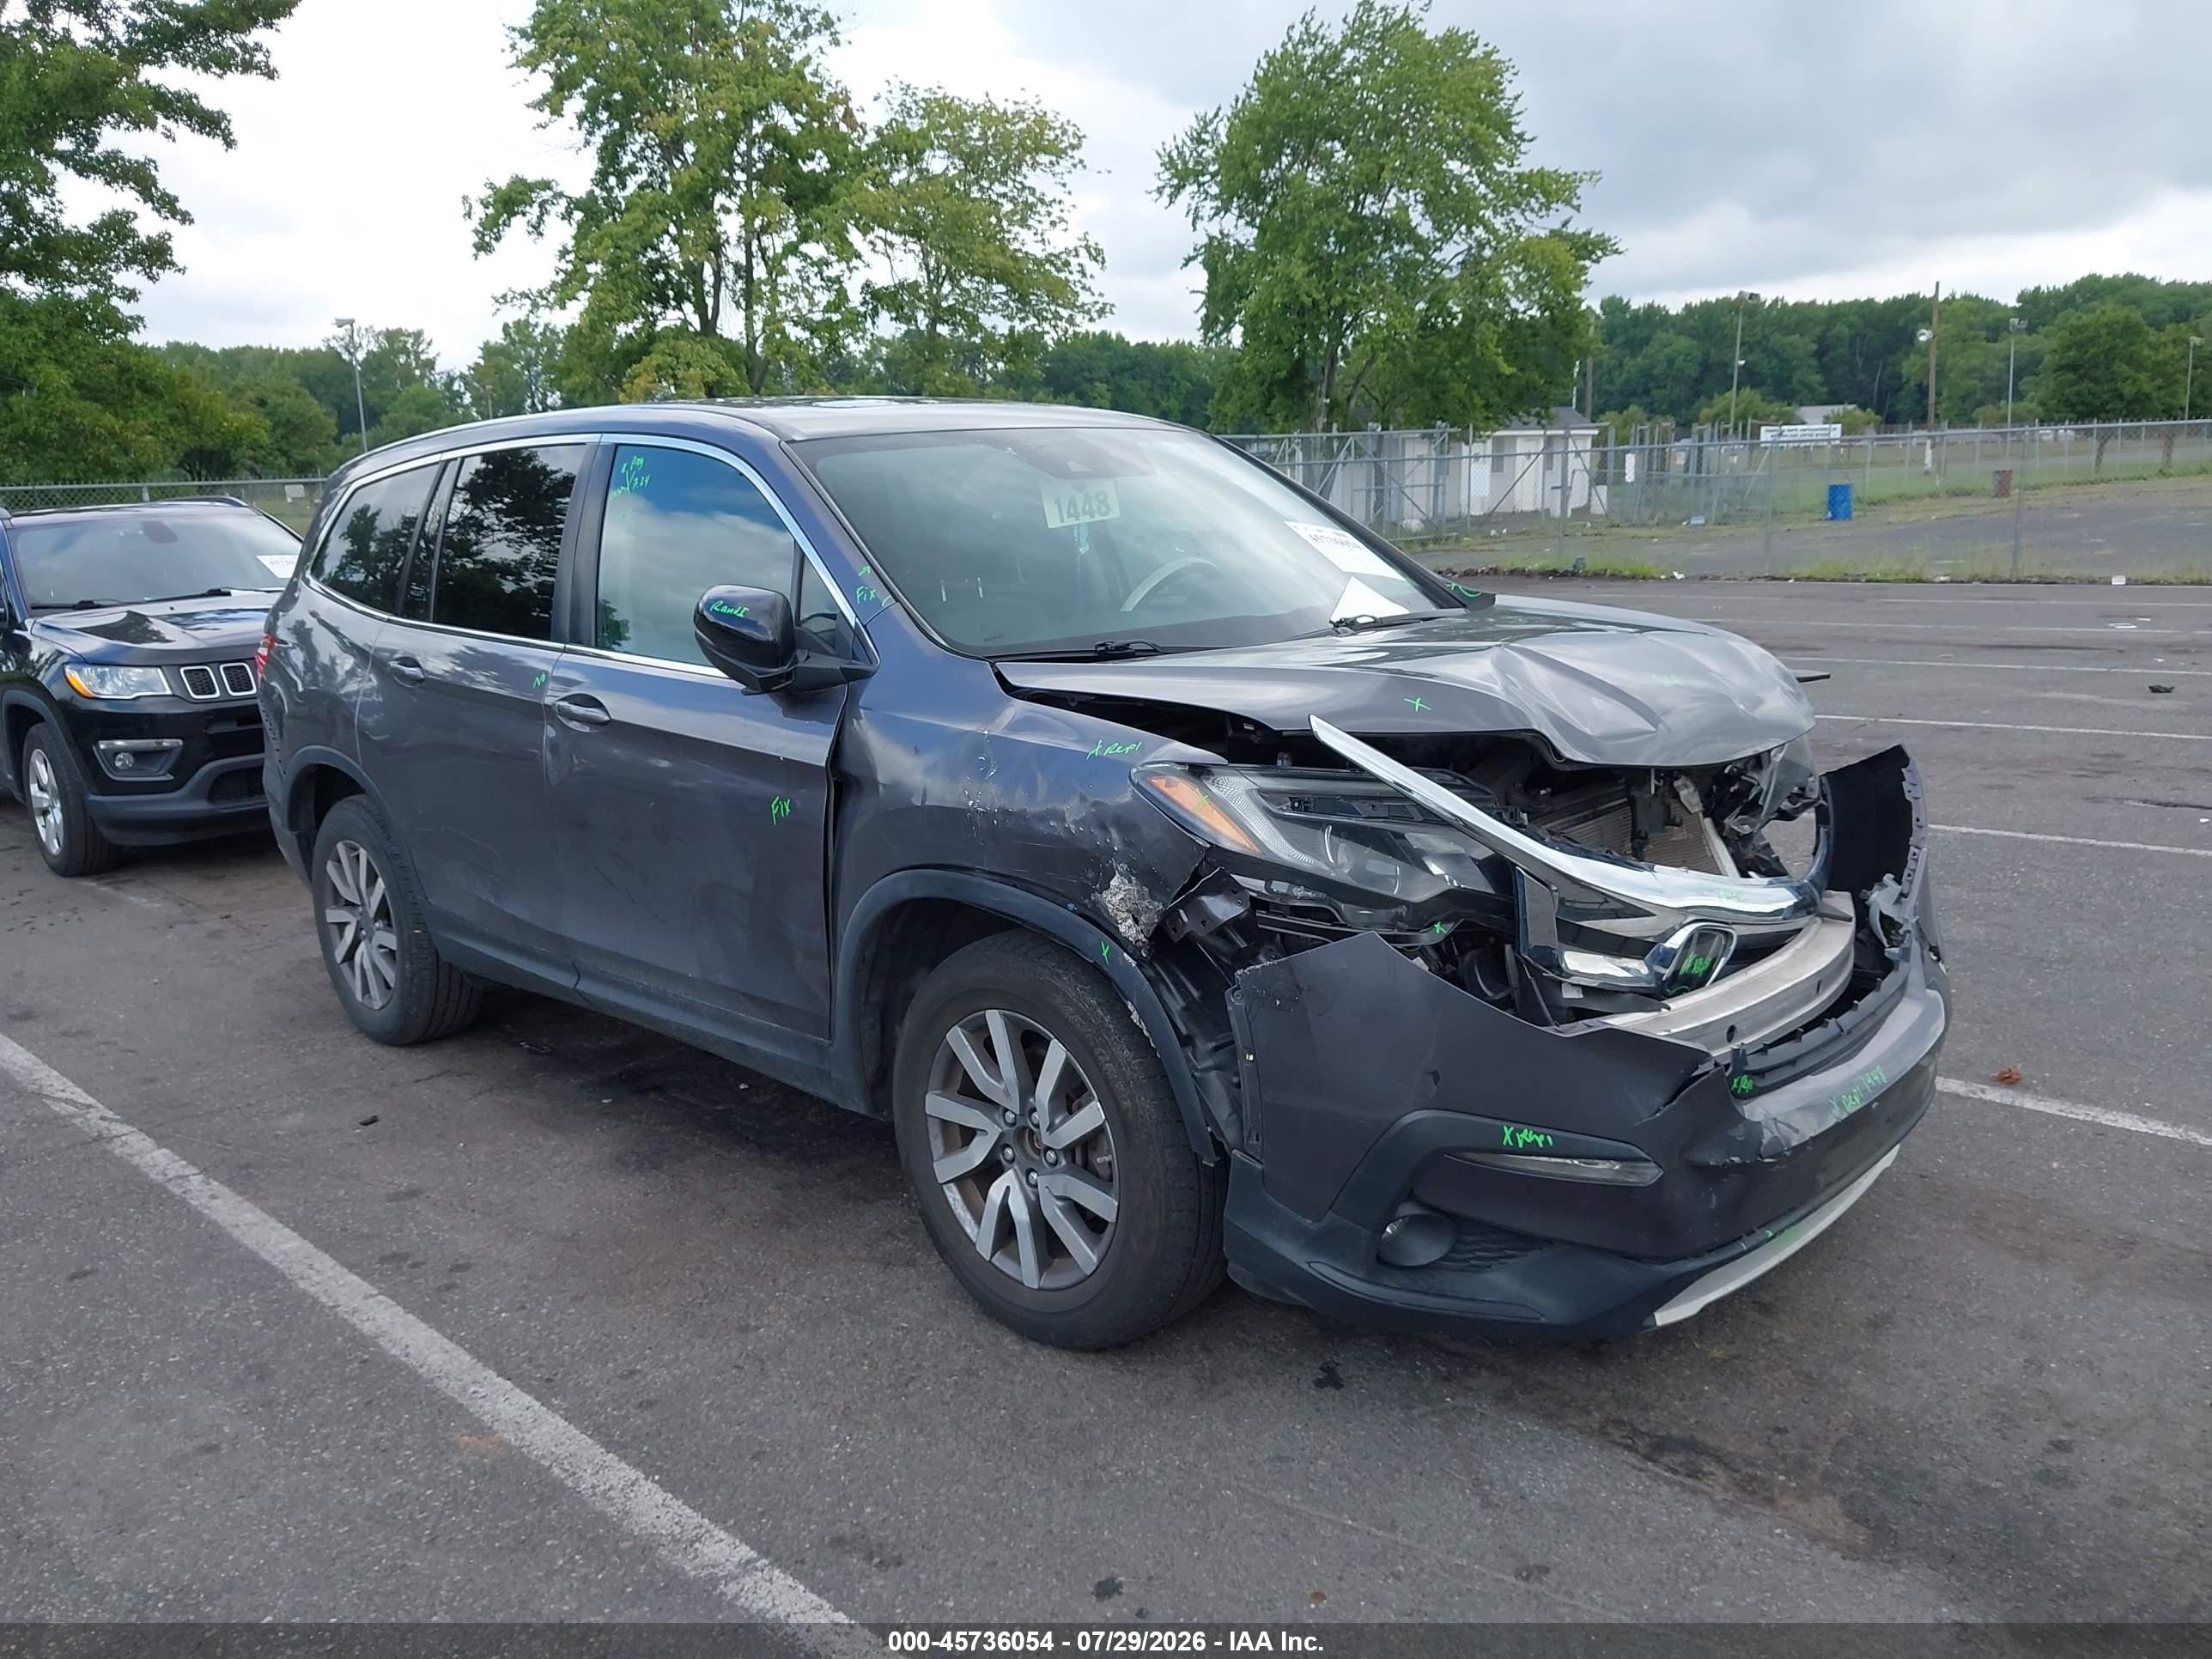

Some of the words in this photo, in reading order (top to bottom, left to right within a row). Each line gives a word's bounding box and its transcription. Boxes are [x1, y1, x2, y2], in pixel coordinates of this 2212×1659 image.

[1053, 490, 1112, 524] 1448
[855, 585, 877, 605] Fix
[771, 795, 791, 826] Fix
